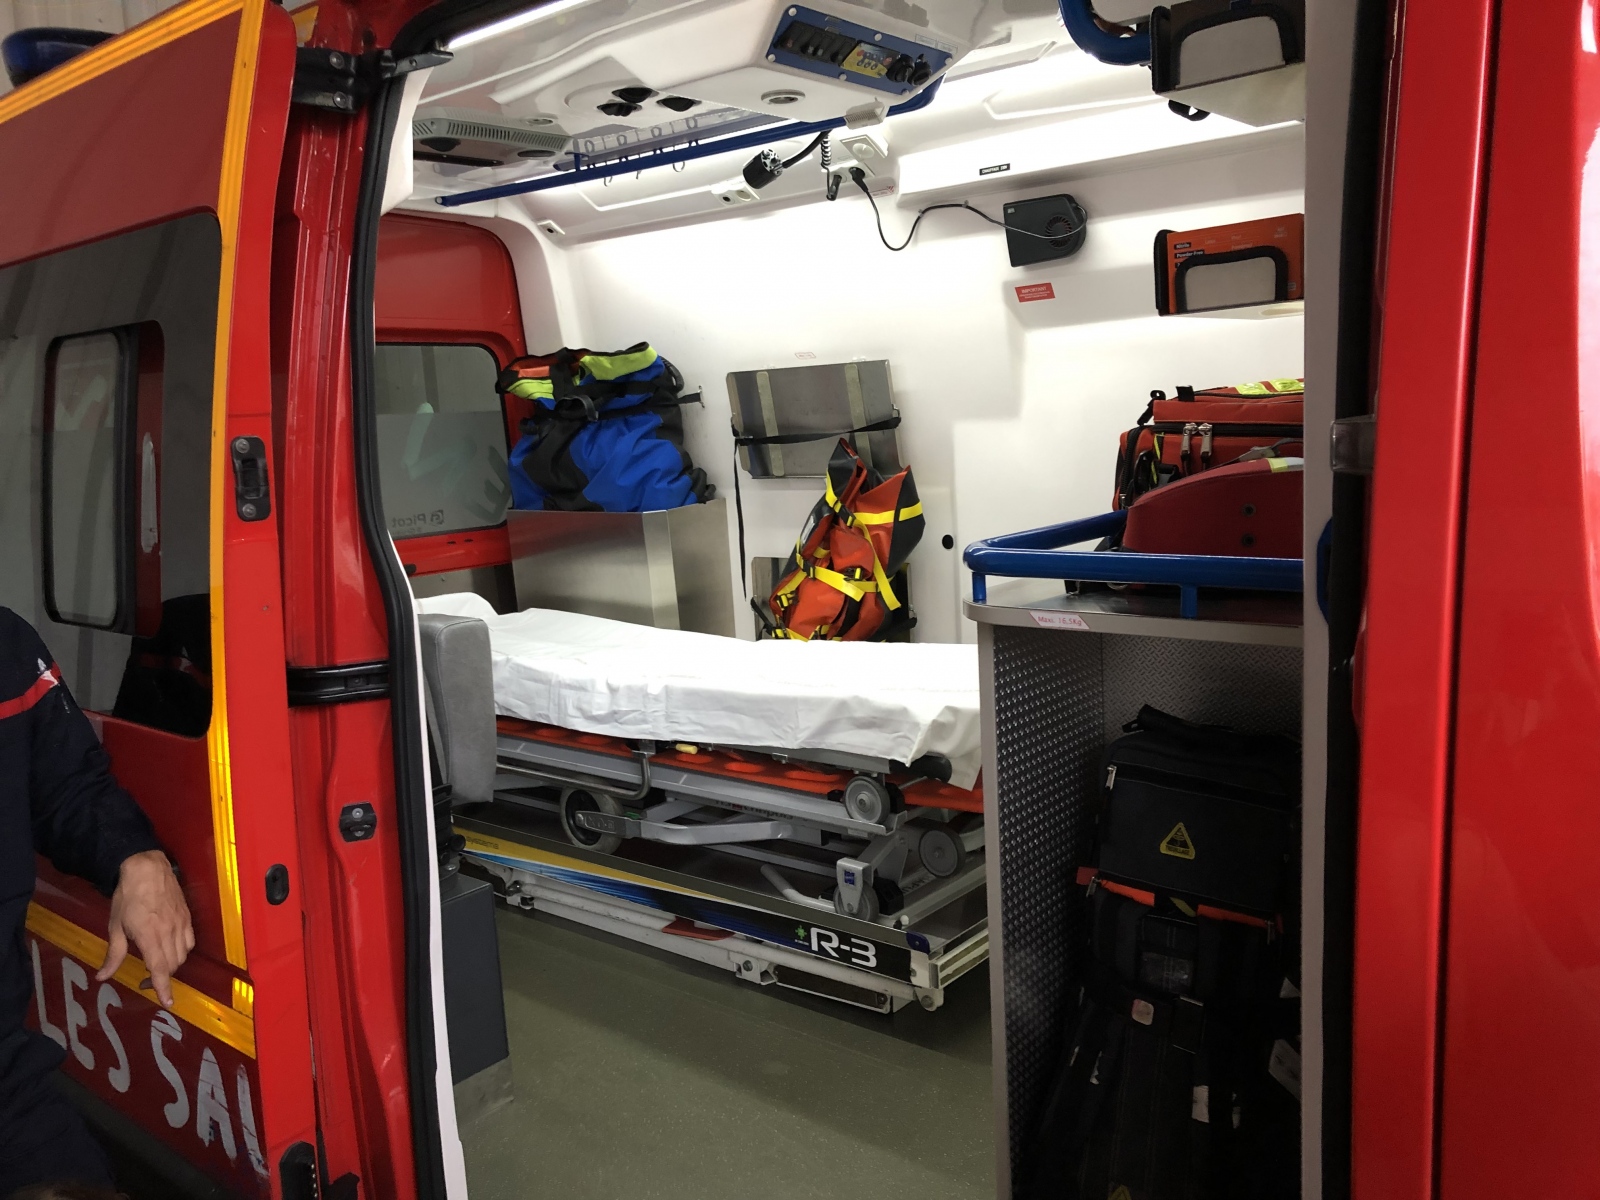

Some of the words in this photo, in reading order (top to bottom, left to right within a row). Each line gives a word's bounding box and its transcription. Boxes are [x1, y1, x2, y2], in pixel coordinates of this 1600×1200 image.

[1021, 286, 1047, 294] IMPORTANT
[810, 927, 877, 968] R-3
[31, 939, 132, 1093] LES
